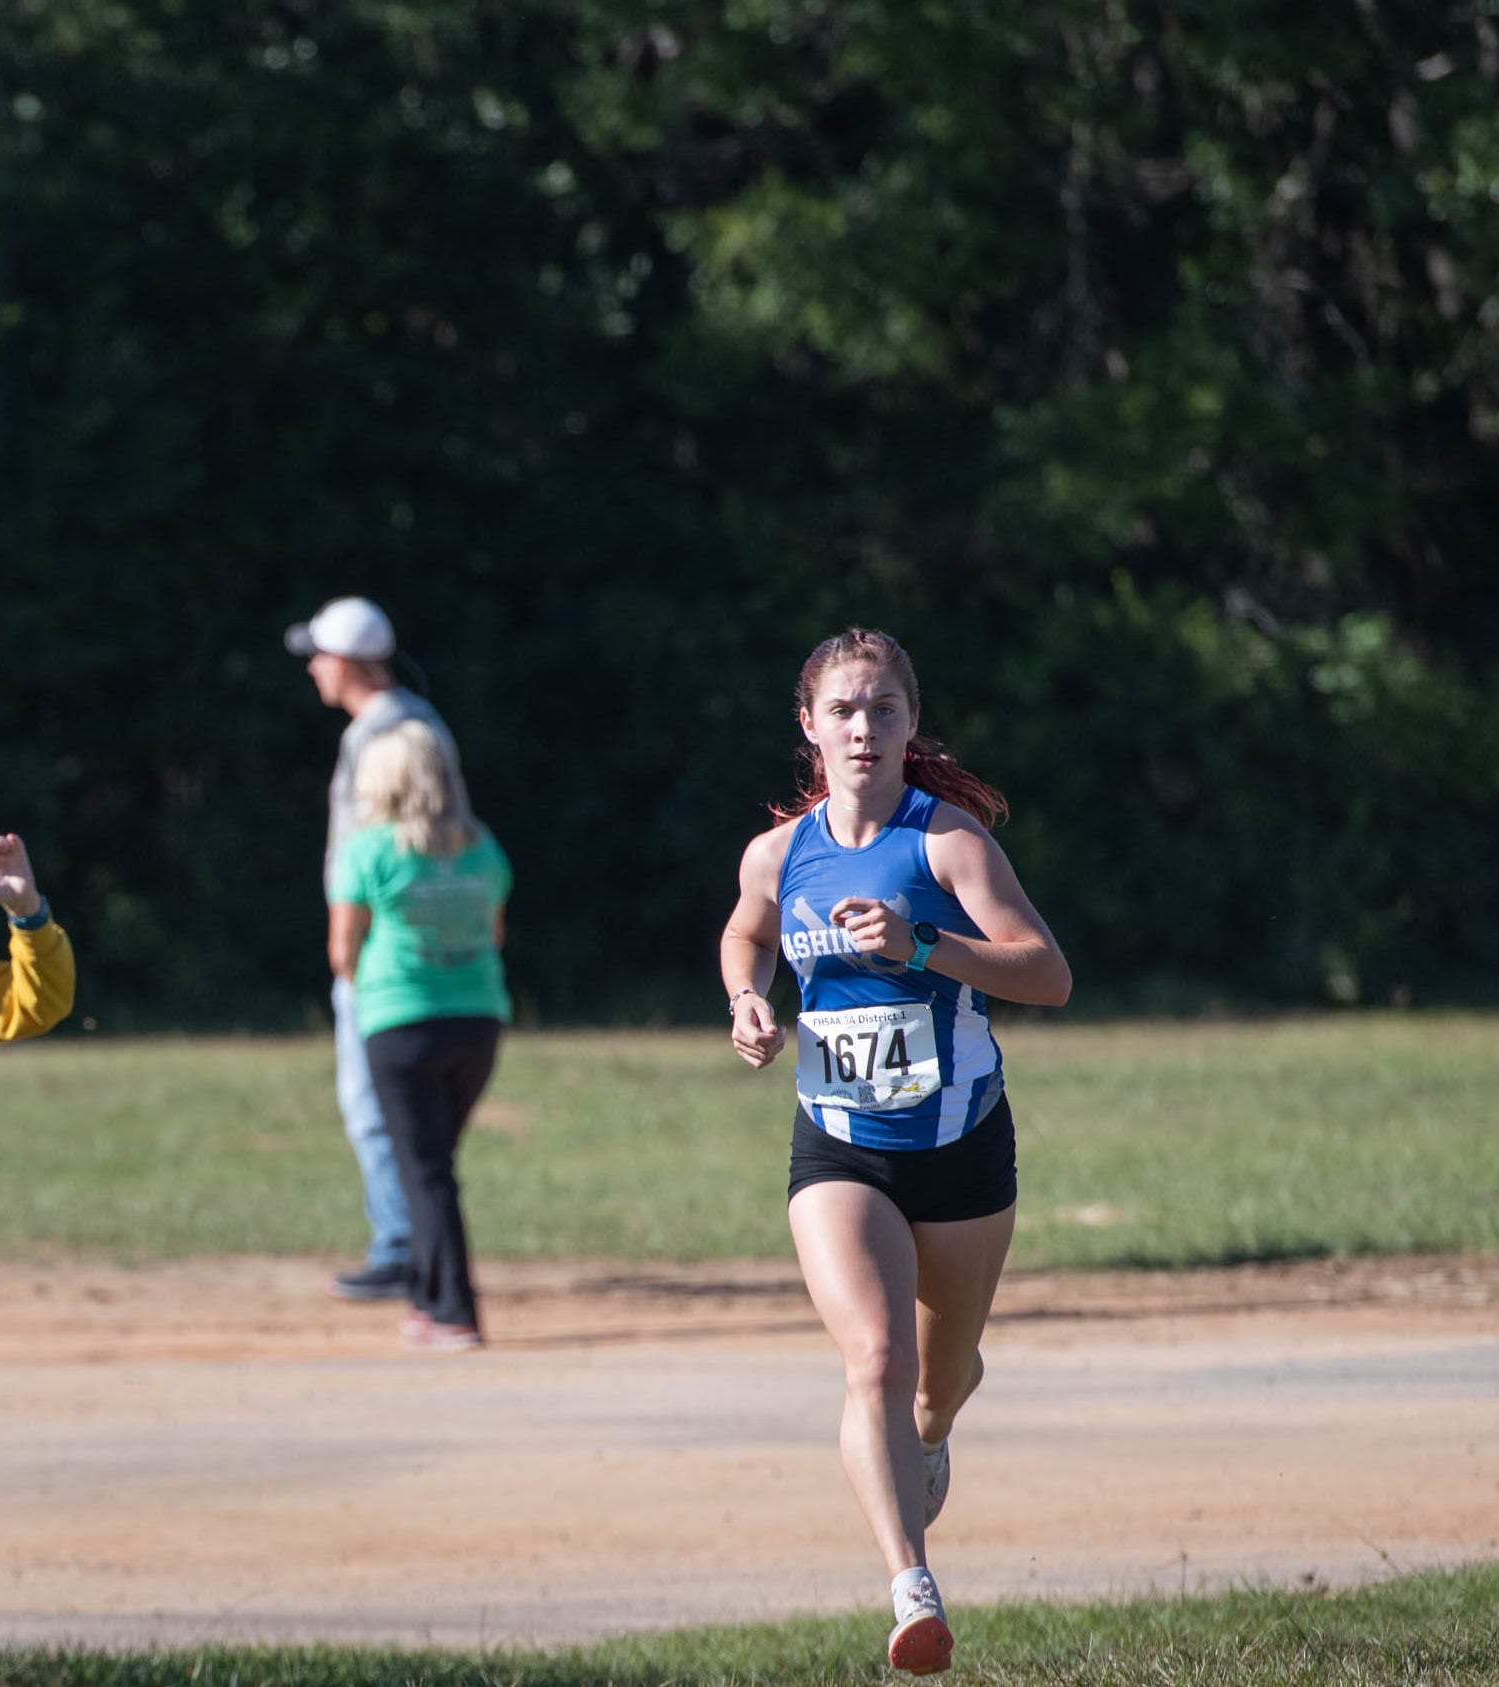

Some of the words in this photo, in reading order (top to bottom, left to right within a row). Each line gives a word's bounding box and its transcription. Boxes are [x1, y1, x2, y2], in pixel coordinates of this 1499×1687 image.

[858, 1012, 897, 1024] District
[900, 1010, 908, 1020] 1
[816, 1028, 912, 1084] 1674
